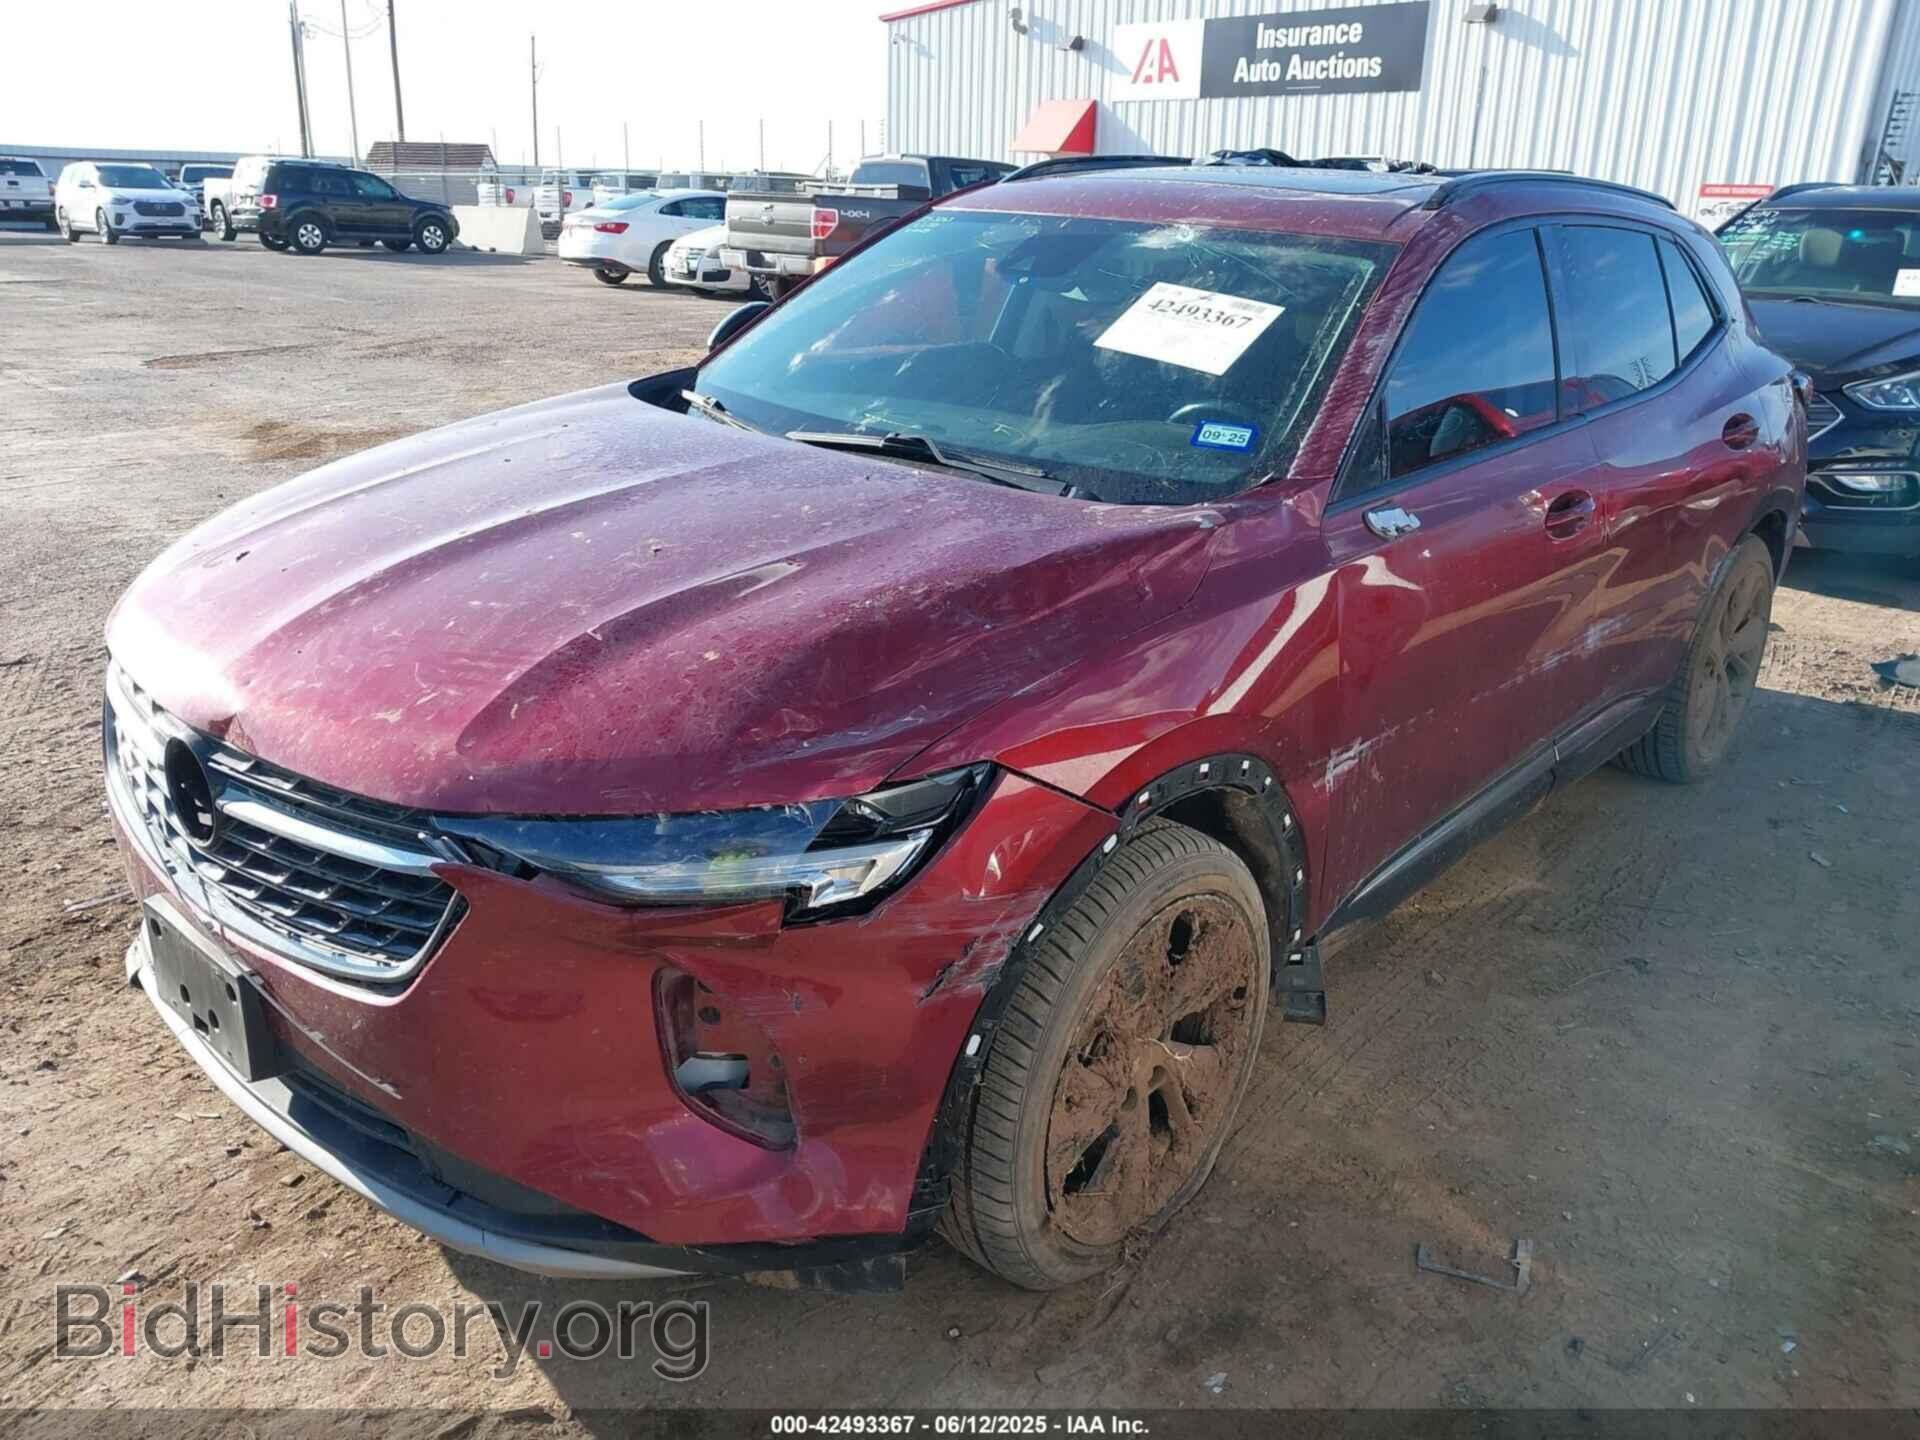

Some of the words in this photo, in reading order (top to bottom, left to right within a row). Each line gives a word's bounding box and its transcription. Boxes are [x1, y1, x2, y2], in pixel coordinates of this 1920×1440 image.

[1256, 22, 1362, 49] Insurance
[1233, 57, 1281, 83] Auto
[1286, 52, 1382, 81] Auctions
[1147, 298, 1253, 328] 42493367
